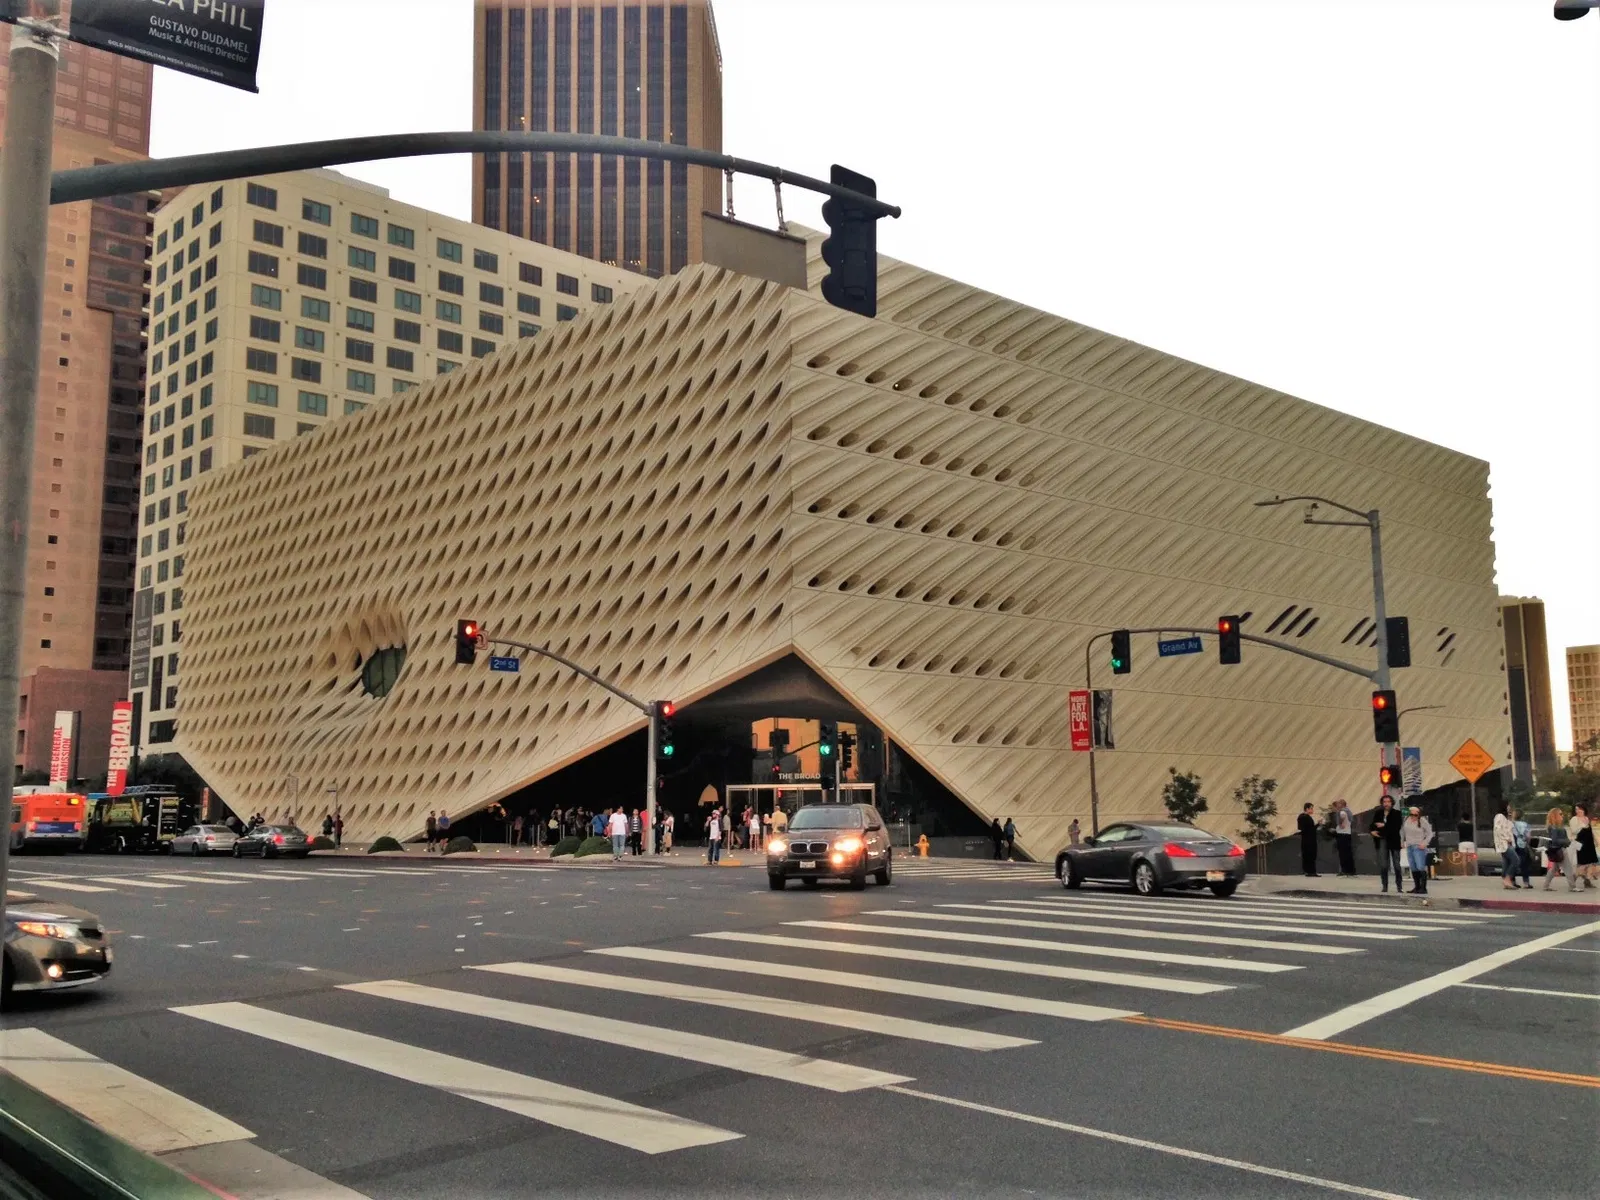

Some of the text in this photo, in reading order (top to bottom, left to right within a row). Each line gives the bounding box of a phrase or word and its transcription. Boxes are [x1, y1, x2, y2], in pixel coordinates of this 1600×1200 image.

[193, 0, 252, 31] PHIL
[148, 27, 249, 63] Music & Artistic Director
[150, 15, 250, 54] GUSTAVO DUDAMEL
[1161, 640, 1198, 653] Grand Av
[1071, 702, 1086, 712] ART
[1071, 711, 1087, 721] FOR
[1071, 721, 1088, 732] L.A.
[50, 726, 62, 782] FREE GENERAL
[60, 738, 71, 782] ADMISSION
[106, 709, 132, 787] THE BROAD
